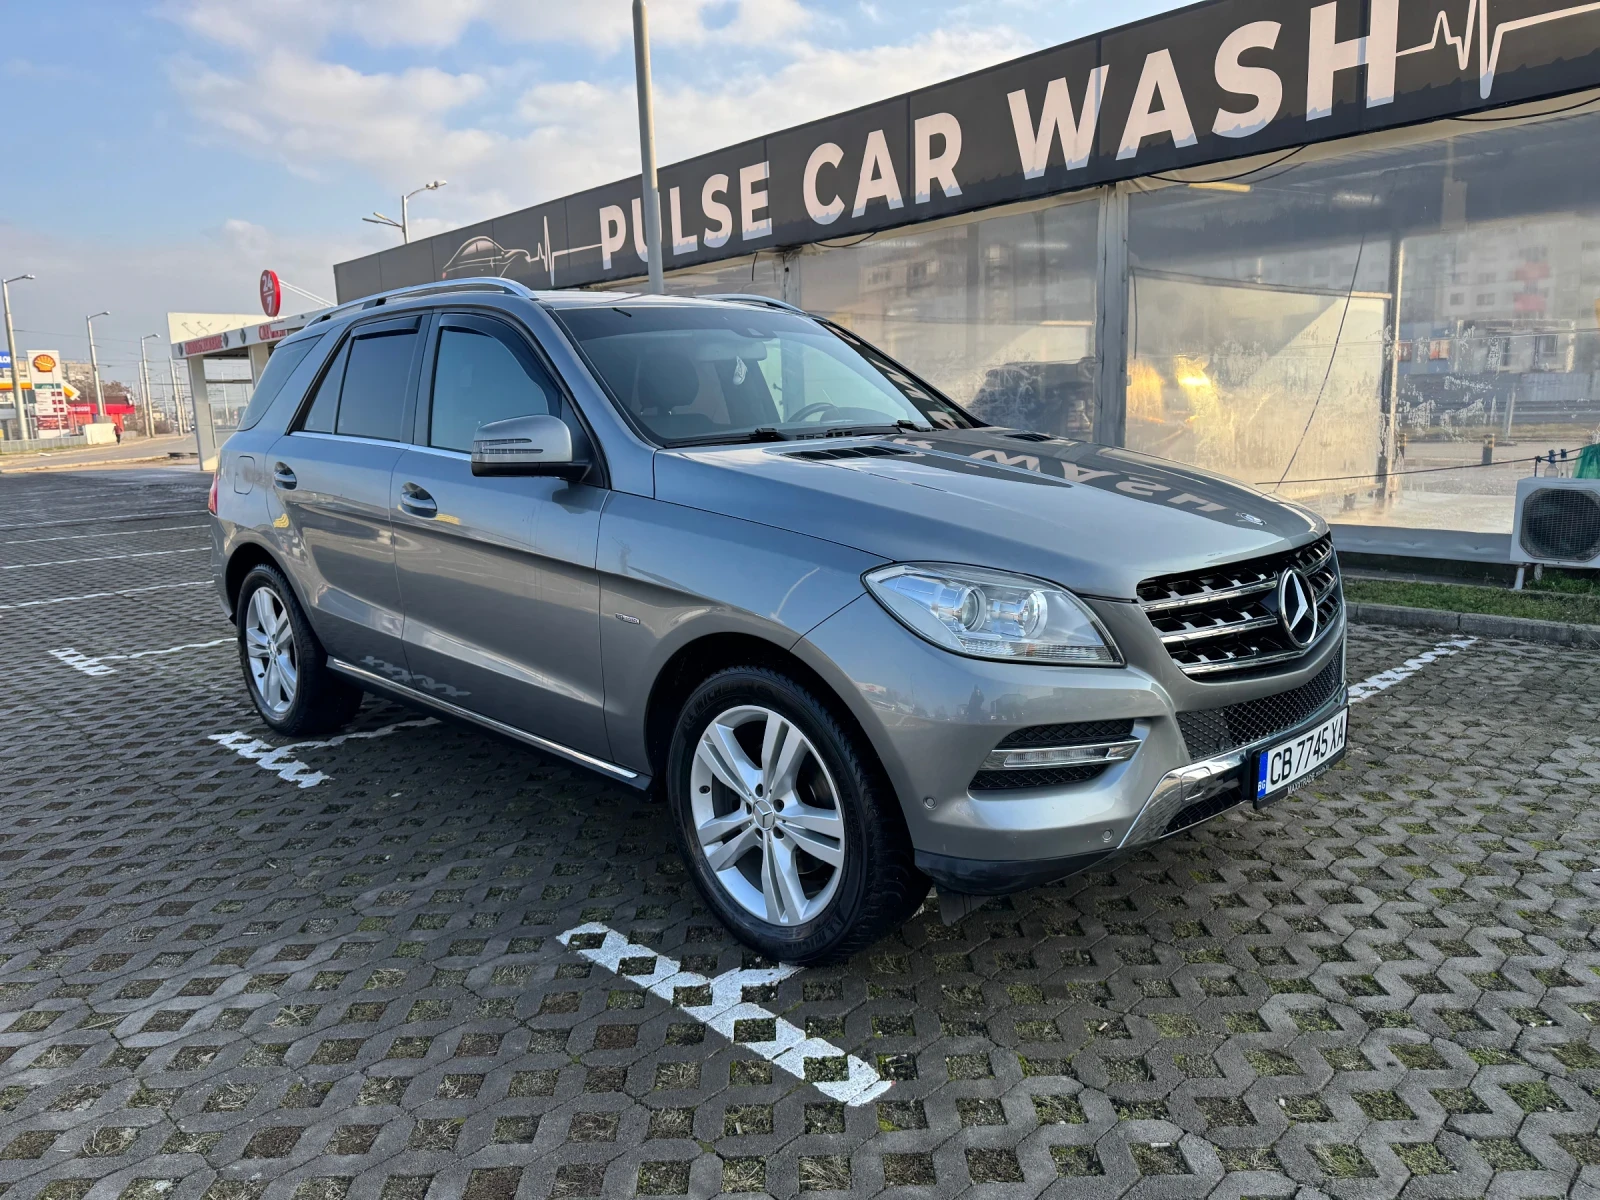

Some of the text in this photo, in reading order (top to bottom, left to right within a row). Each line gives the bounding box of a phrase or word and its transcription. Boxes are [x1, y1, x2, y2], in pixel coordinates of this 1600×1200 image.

[599, 0, 1399, 270] PULSE CAR WASH
[262, 274, 273, 292] 24
[266, 296, 273, 314] 7
[1271, 716, 1343, 785] CB 7745 XA
[1257, 779, 1266, 792] BG
